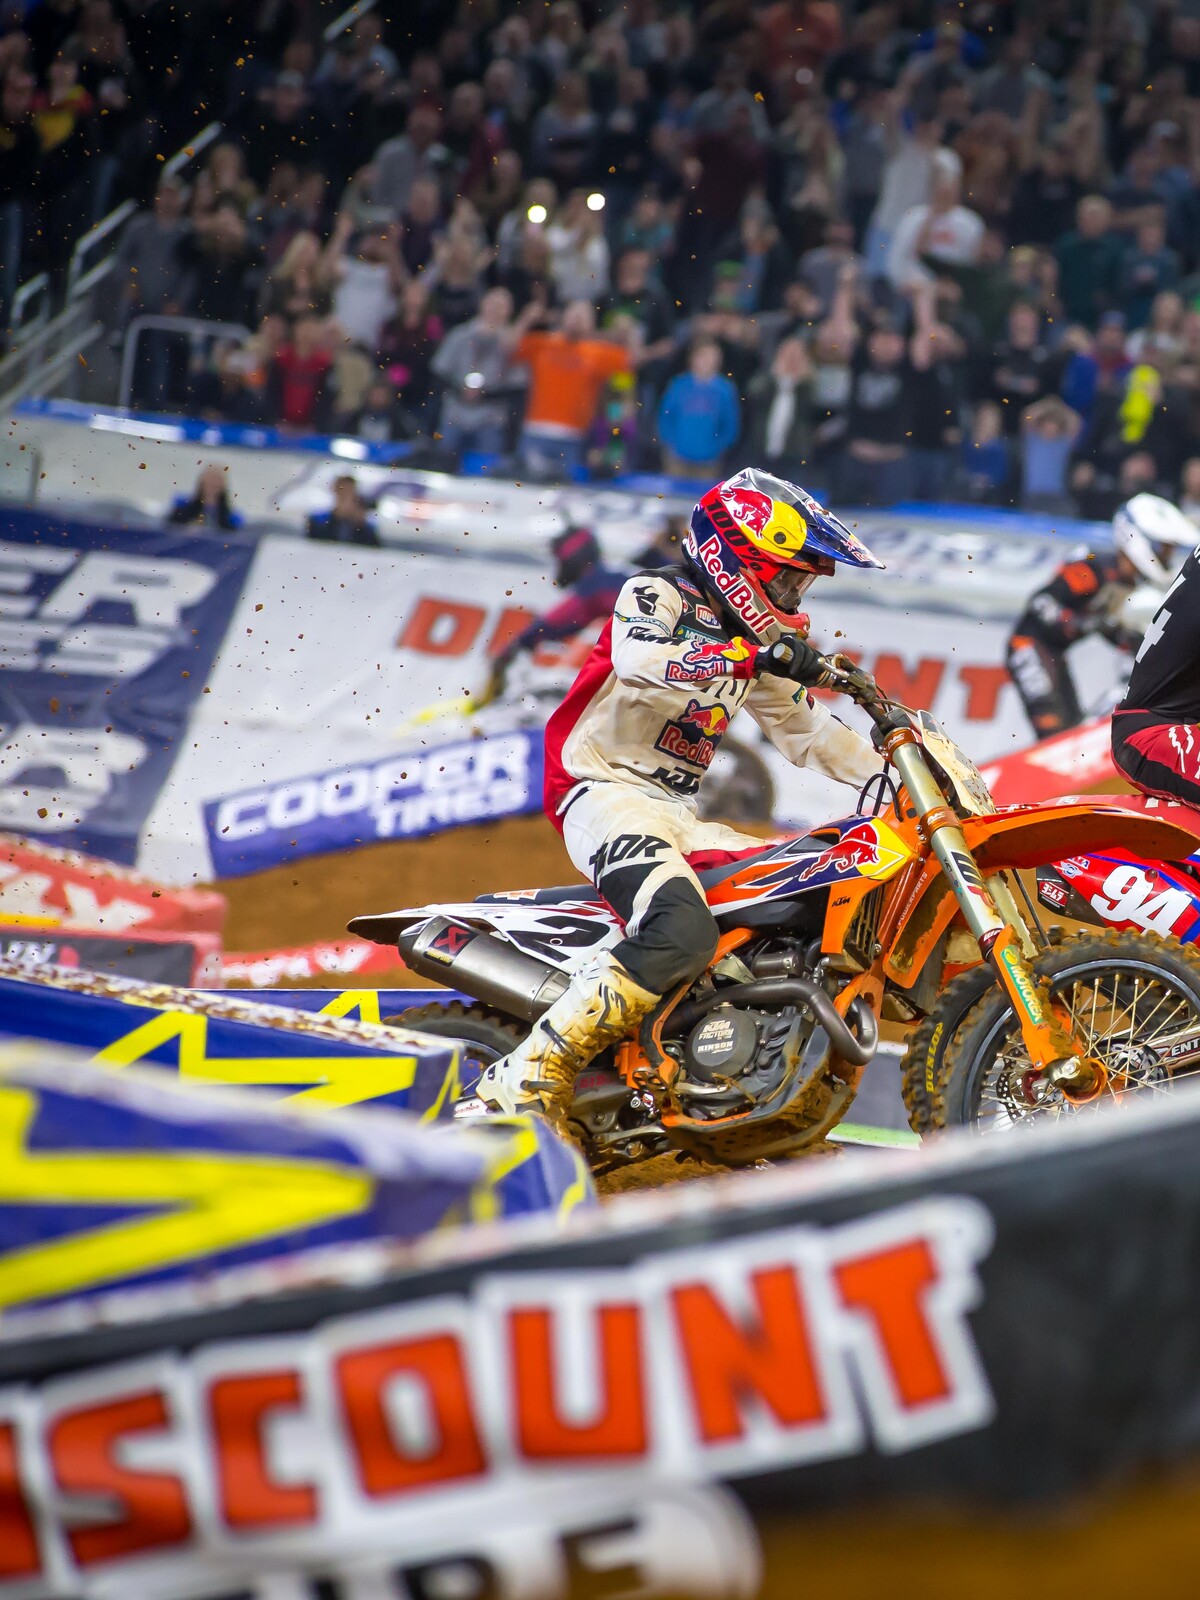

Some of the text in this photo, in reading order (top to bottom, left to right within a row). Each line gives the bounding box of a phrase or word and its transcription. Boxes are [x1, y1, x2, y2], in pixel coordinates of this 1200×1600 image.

[707, 499, 763, 571] 100%
[700, 534, 777, 635] Red Bull
[659, 725, 705, 762] Red
[215, 734, 530, 842] COOPER
[368, 787, 529, 838] TIRES
[1091, 865, 1194, 939] 94
[507, 915, 611, 963] 2
[699, 1028, 734, 1040] FACTORY
[703, 1020, 731, 1033] KTM
